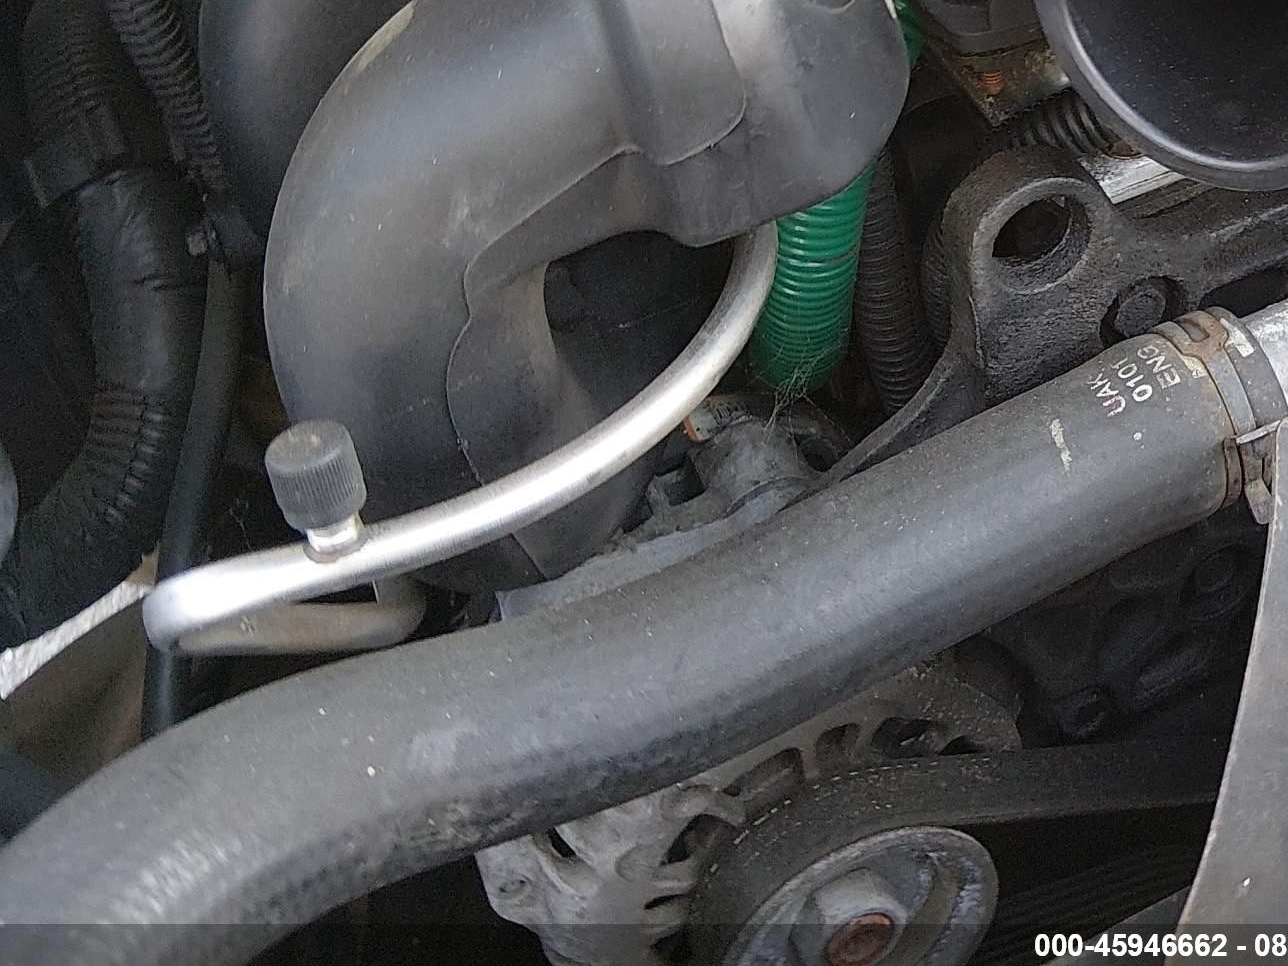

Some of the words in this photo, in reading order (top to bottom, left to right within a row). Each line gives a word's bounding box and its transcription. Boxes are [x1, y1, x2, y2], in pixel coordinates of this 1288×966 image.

[1110, 357, 1153, 403] 0101
[1136, 344, 1181, 390] ENG
[1087, 372, 1127, 418] UAK
